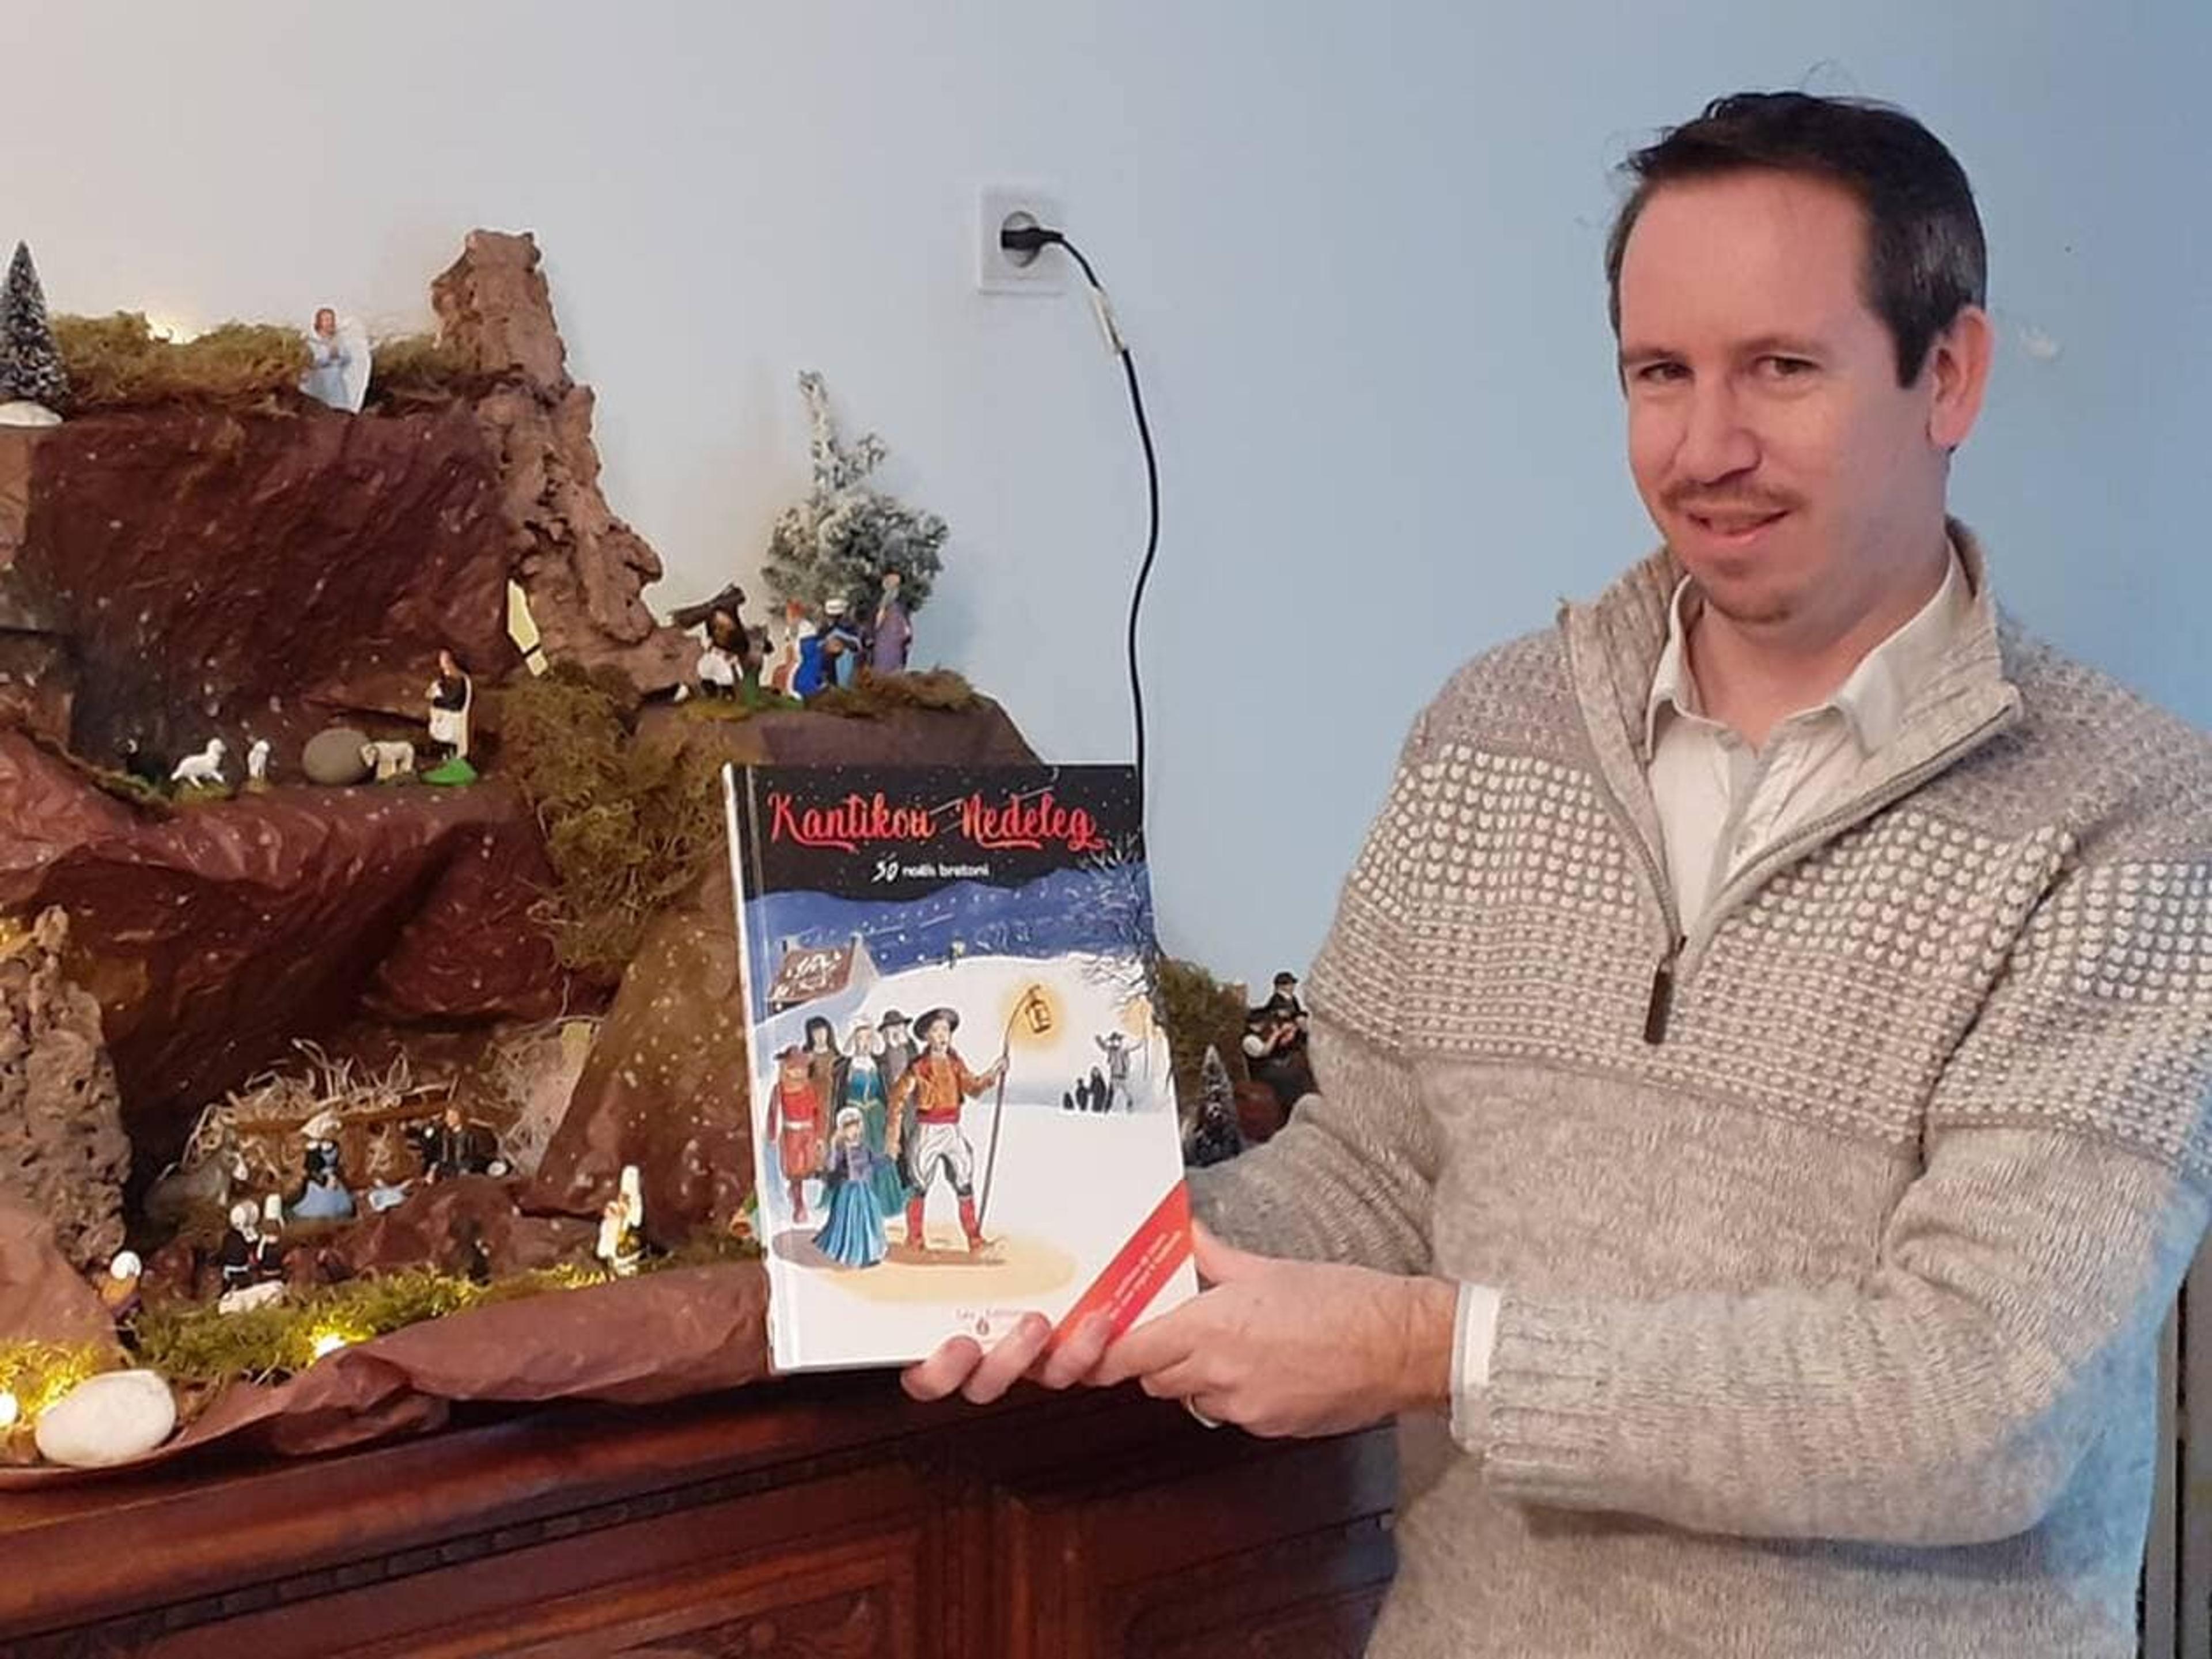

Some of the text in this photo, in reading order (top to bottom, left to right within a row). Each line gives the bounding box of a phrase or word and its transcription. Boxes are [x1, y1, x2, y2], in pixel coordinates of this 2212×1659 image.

[768, 793, 1107, 854] Kantikou Nedeleg
[871, 860, 899, 882] 50
